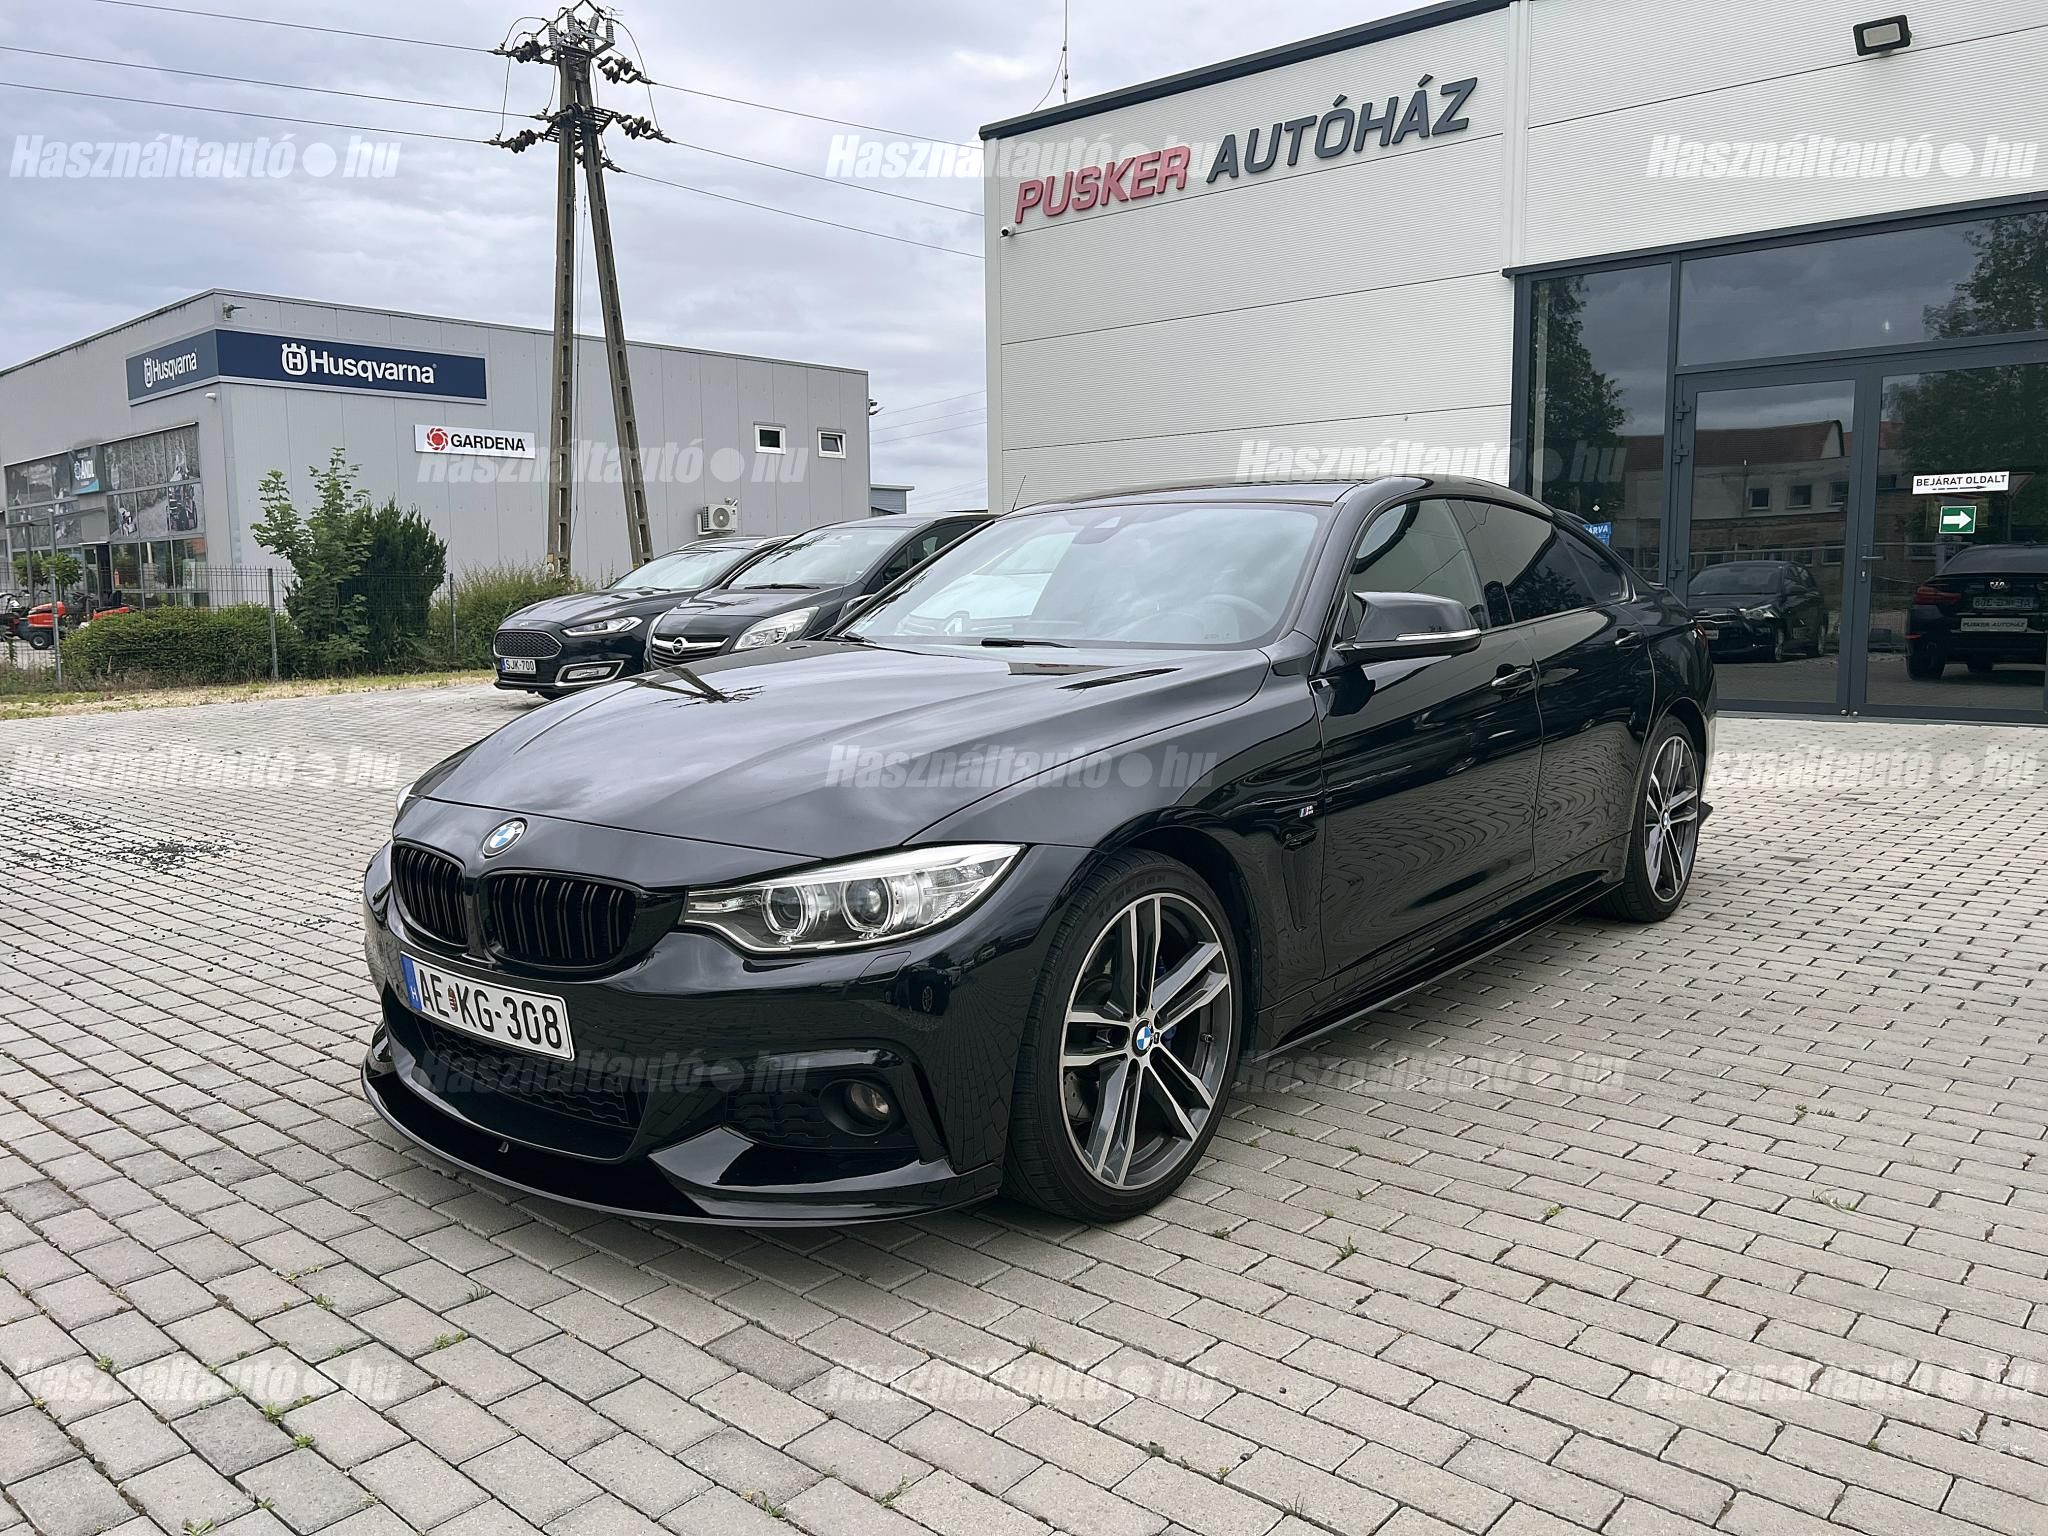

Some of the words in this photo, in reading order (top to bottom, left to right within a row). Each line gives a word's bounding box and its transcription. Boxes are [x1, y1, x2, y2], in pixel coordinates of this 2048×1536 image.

[1014, 146, 1191, 224] PUSKER
[1206, 74, 1478, 183] AUTÓHÁZ
[152, 350, 197, 382] Husqvarna
[310, 350, 436, 384] Husqvarna
[450, 433, 526, 452] GARDENA
[1916, 476, 1963, 487] BEJÁRAT
[1965, 474, 2007, 485] OLDALT
[505, 659, 535, 670] SJK-700
